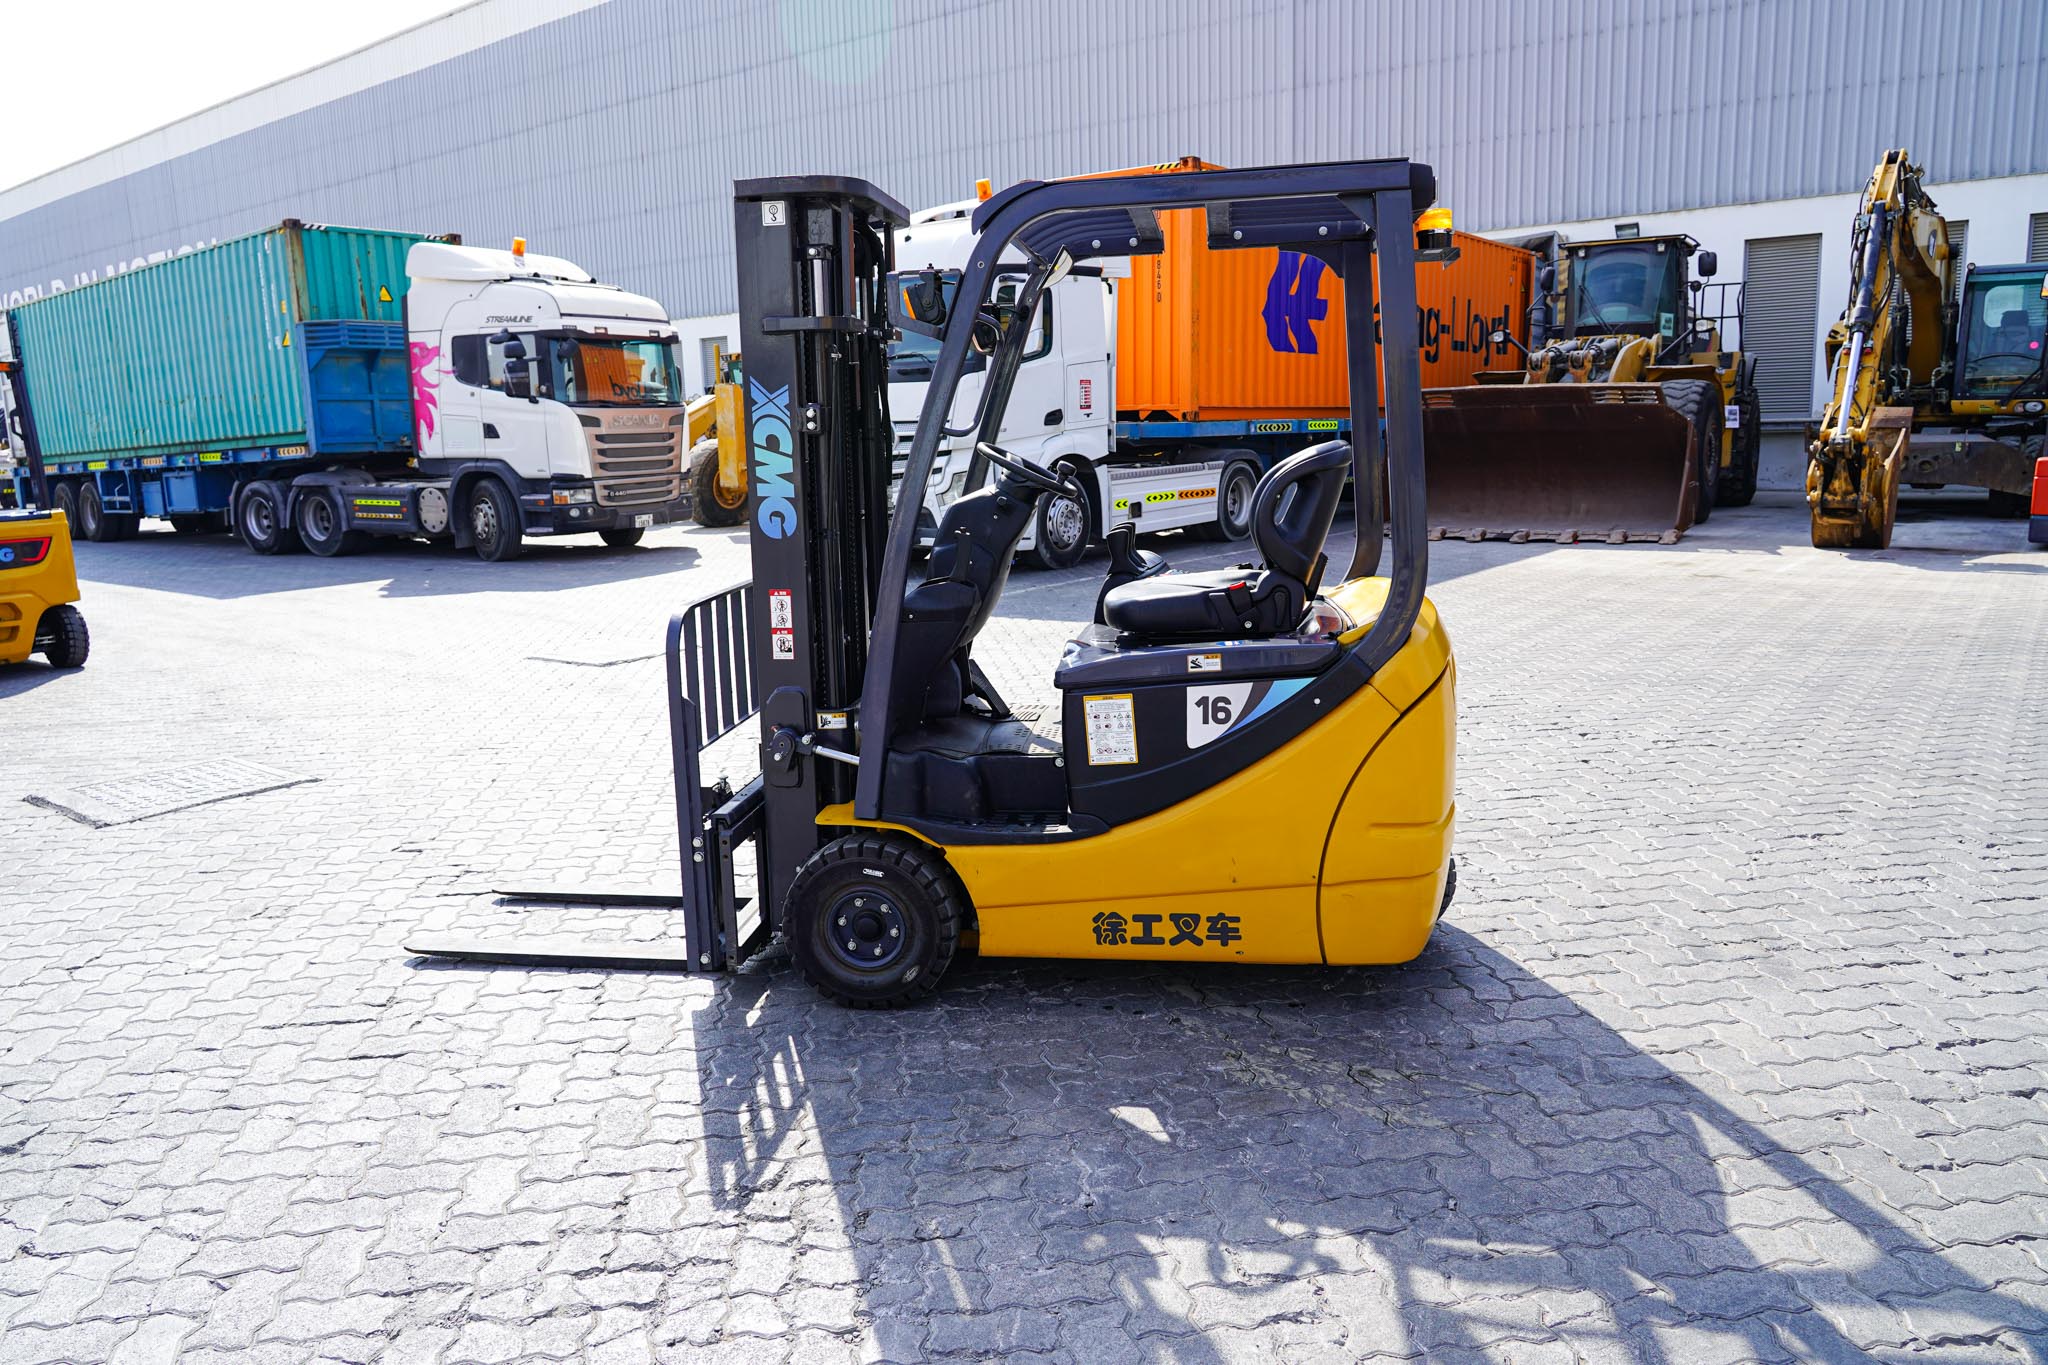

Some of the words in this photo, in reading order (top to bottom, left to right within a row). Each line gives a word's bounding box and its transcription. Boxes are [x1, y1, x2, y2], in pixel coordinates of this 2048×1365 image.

[486, 315, 534, 323] STREAMLINE
[613, 414, 660, 427] SCANIA
[750, 376, 797, 539] XCMG
[1194, 696, 1232, 725] 16
[1092, 911, 1242, 947] 徐工叉车
